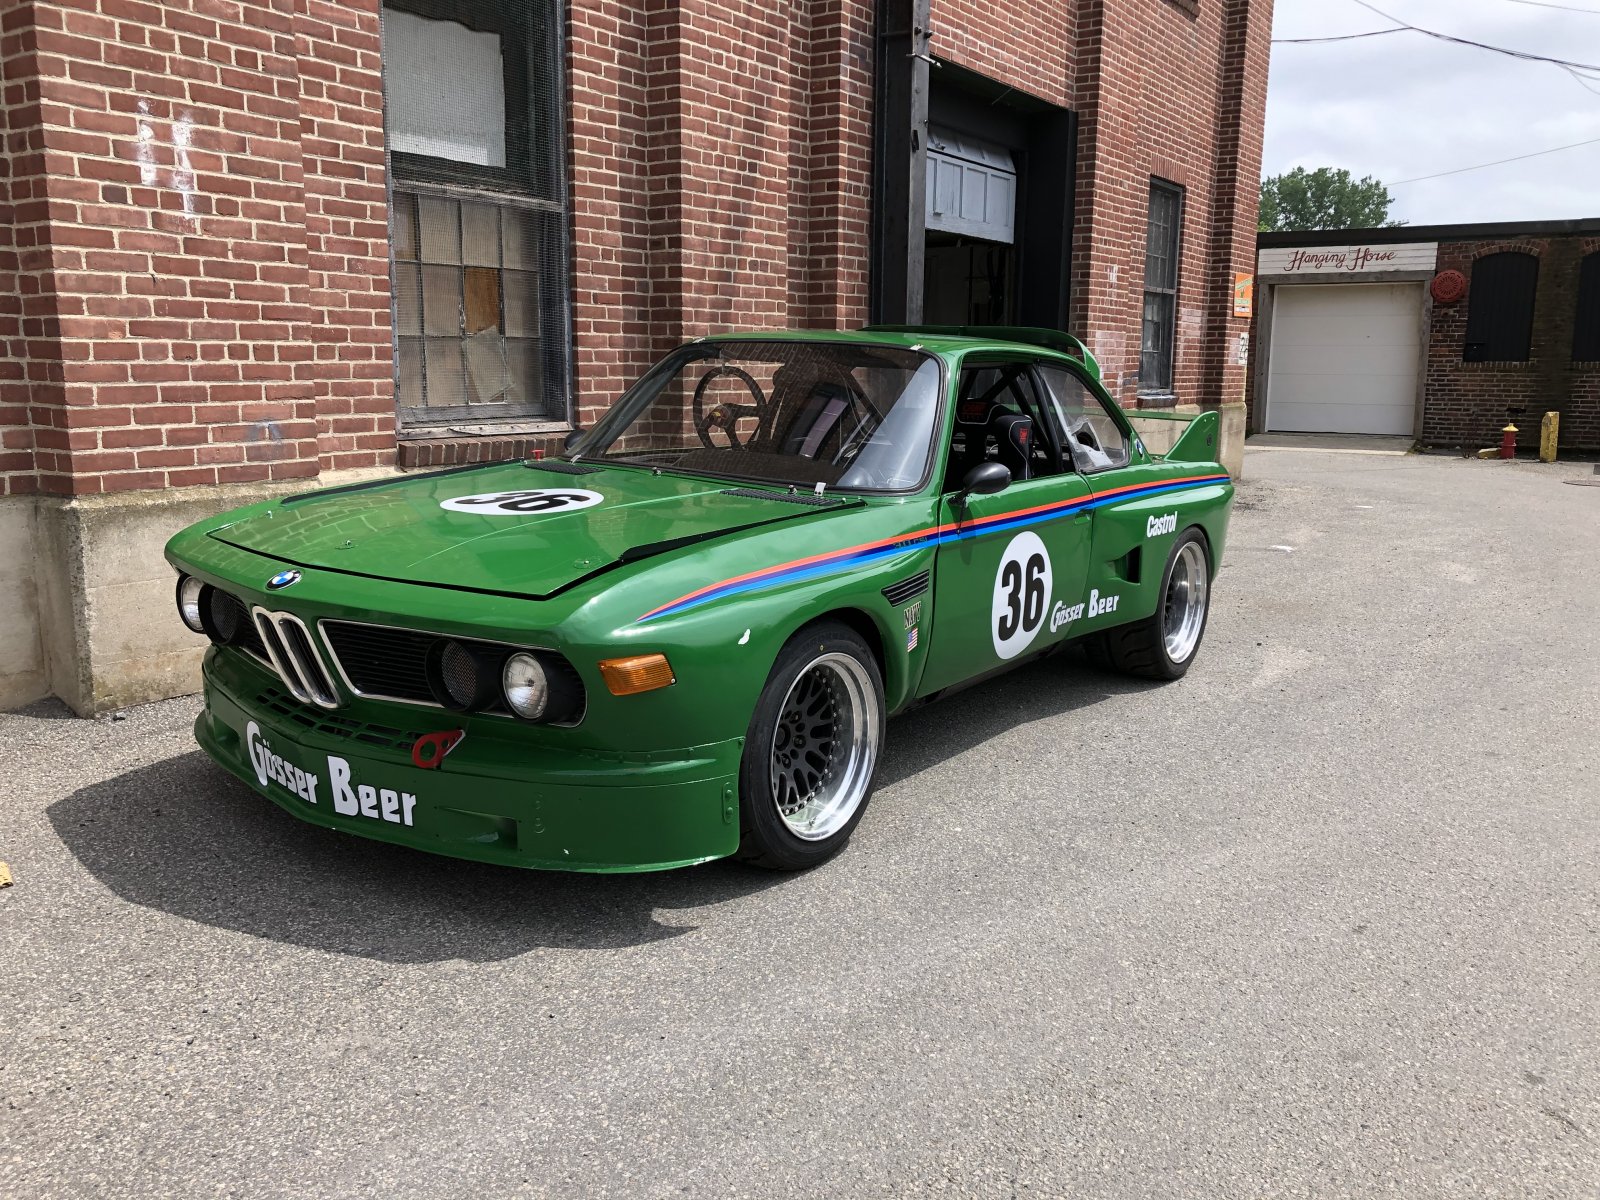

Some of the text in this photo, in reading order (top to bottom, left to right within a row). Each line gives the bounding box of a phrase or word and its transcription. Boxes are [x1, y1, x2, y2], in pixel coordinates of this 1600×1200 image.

[1283, 247, 1398, 272] Hanging Horse
[454, 491, 591, 512] 36
[1146, 510, 1178, 538] Castrol
[998, 552, 1046, 642] 36
[1049, 588, 1120, 633] Gösser Beer
[246, 720, 417, 827] Gösser Beer
